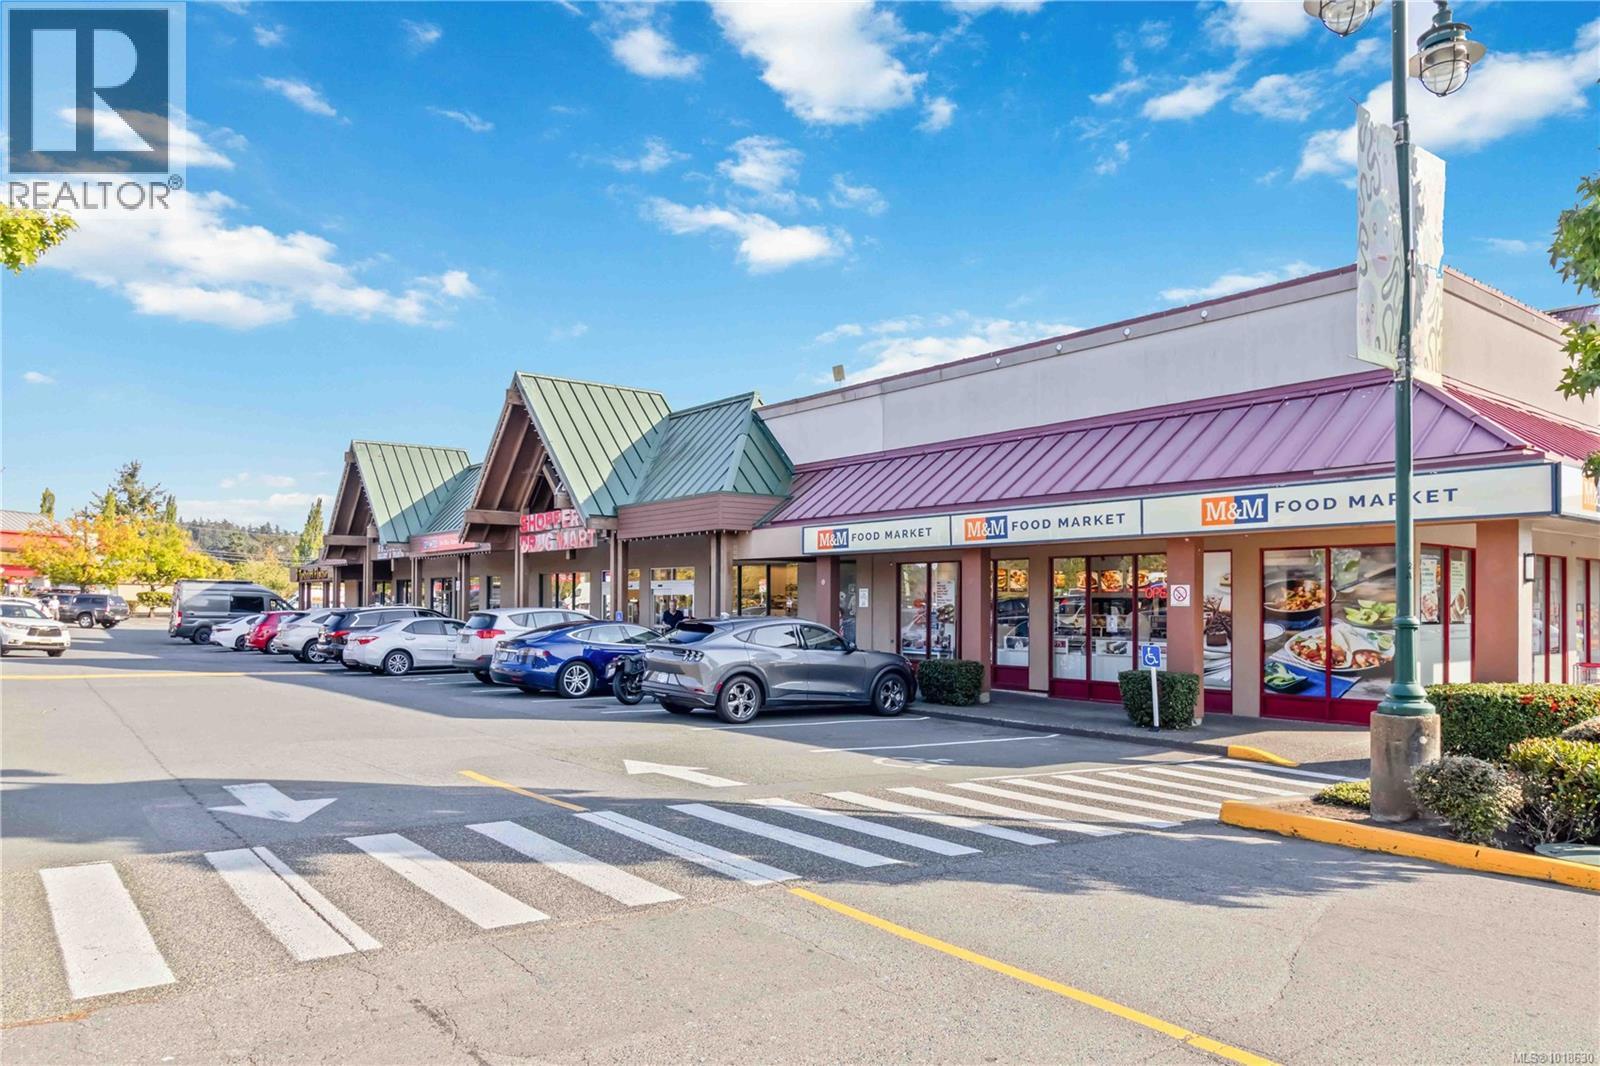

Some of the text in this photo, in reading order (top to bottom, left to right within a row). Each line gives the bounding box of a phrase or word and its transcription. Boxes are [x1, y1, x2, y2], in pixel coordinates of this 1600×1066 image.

[519, 508, 581, 533] SHOPPER
[1205, 497, 1266, 522] M&M
[1275, 497, 1338, 513] FOOD
[818, 527, 933, 548] M&M FOOD MARKET
[966, 512, 1126, 538] M&M FOOD MARKET
[519, 528, 597, 553] DRUG MART
[1145, 587, 1168, 599] OPE
